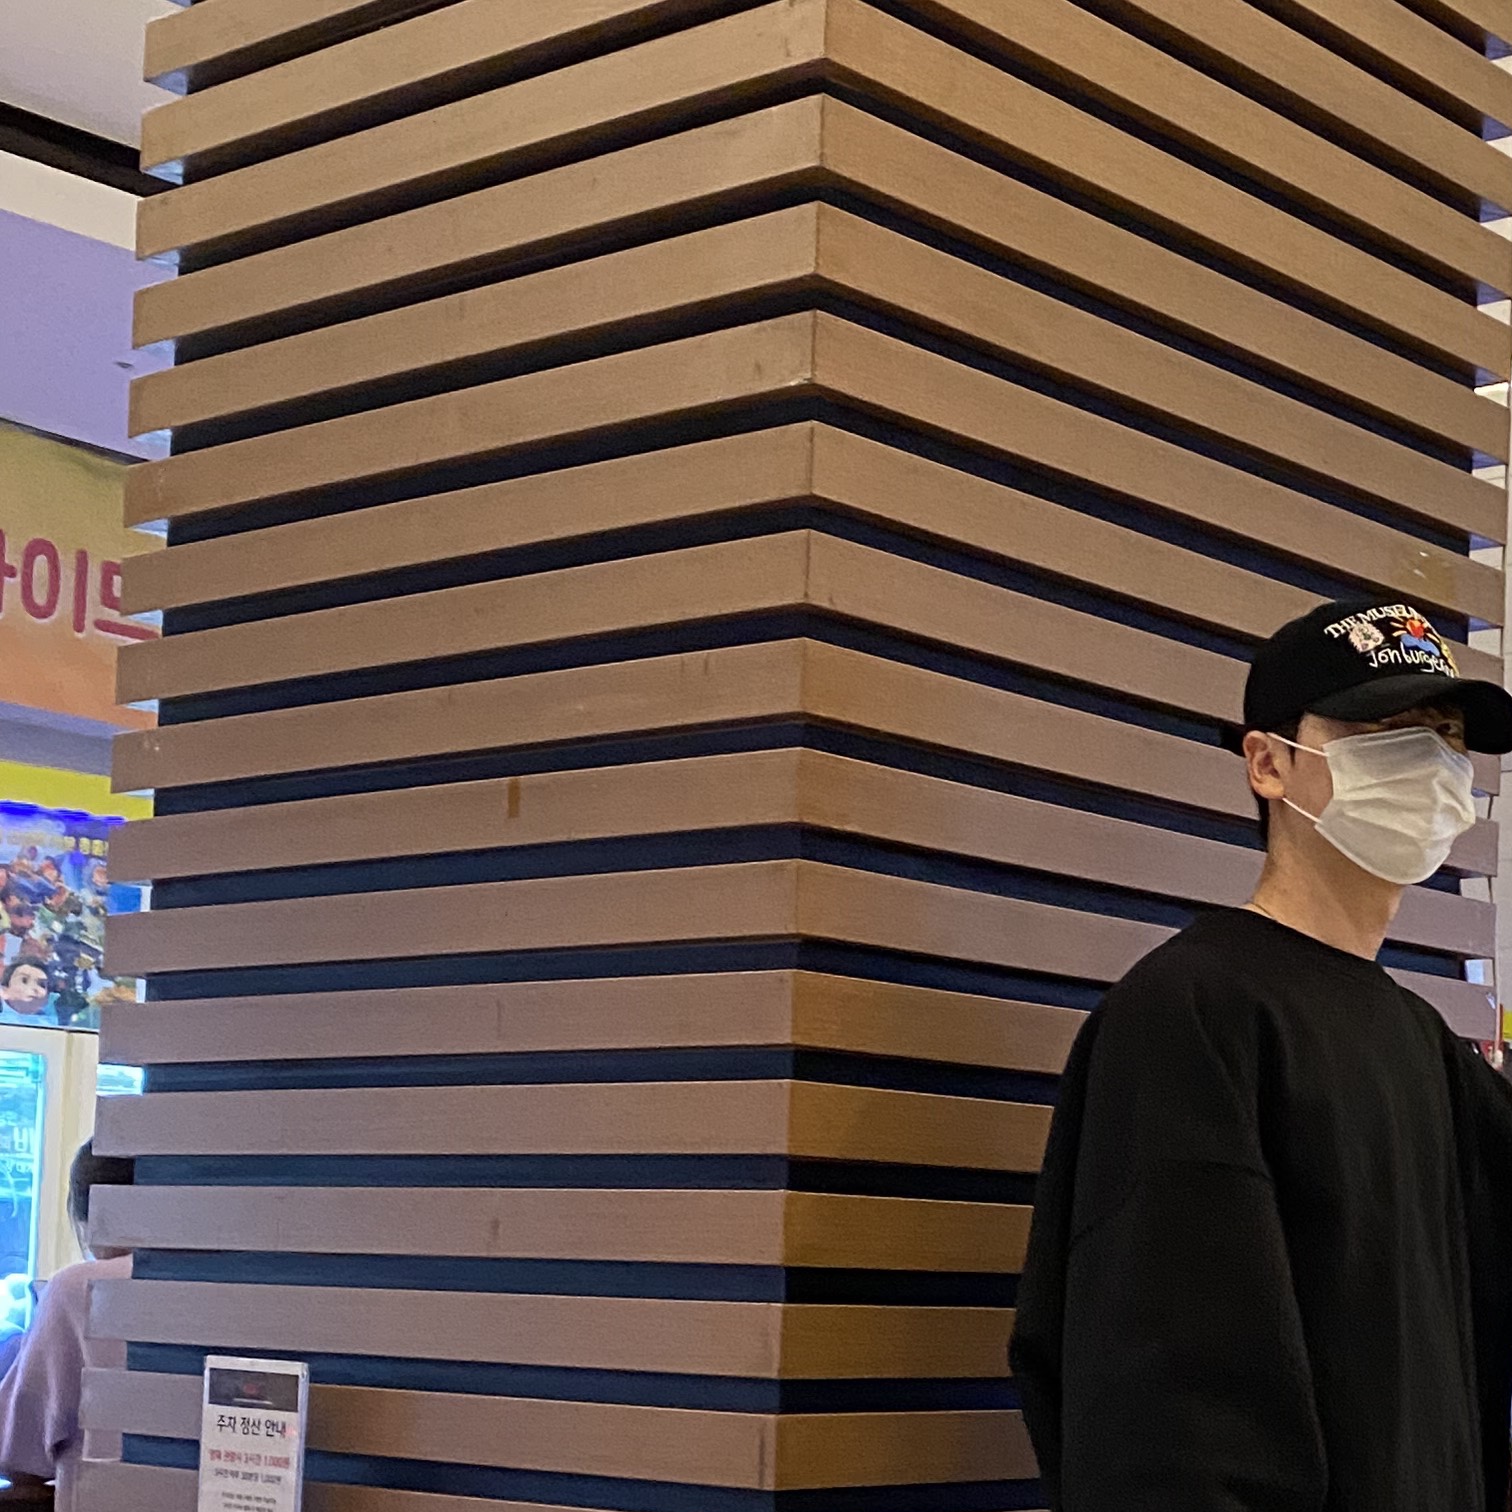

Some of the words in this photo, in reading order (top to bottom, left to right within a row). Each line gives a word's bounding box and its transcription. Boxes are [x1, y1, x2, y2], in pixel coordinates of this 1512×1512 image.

[1324, 616, 1360, 639] THE
[216, 1414, 238, 1434] 주차
[240, 1416, 262, 1436] 정산
[264, 1419, 287, 1438] 안내
